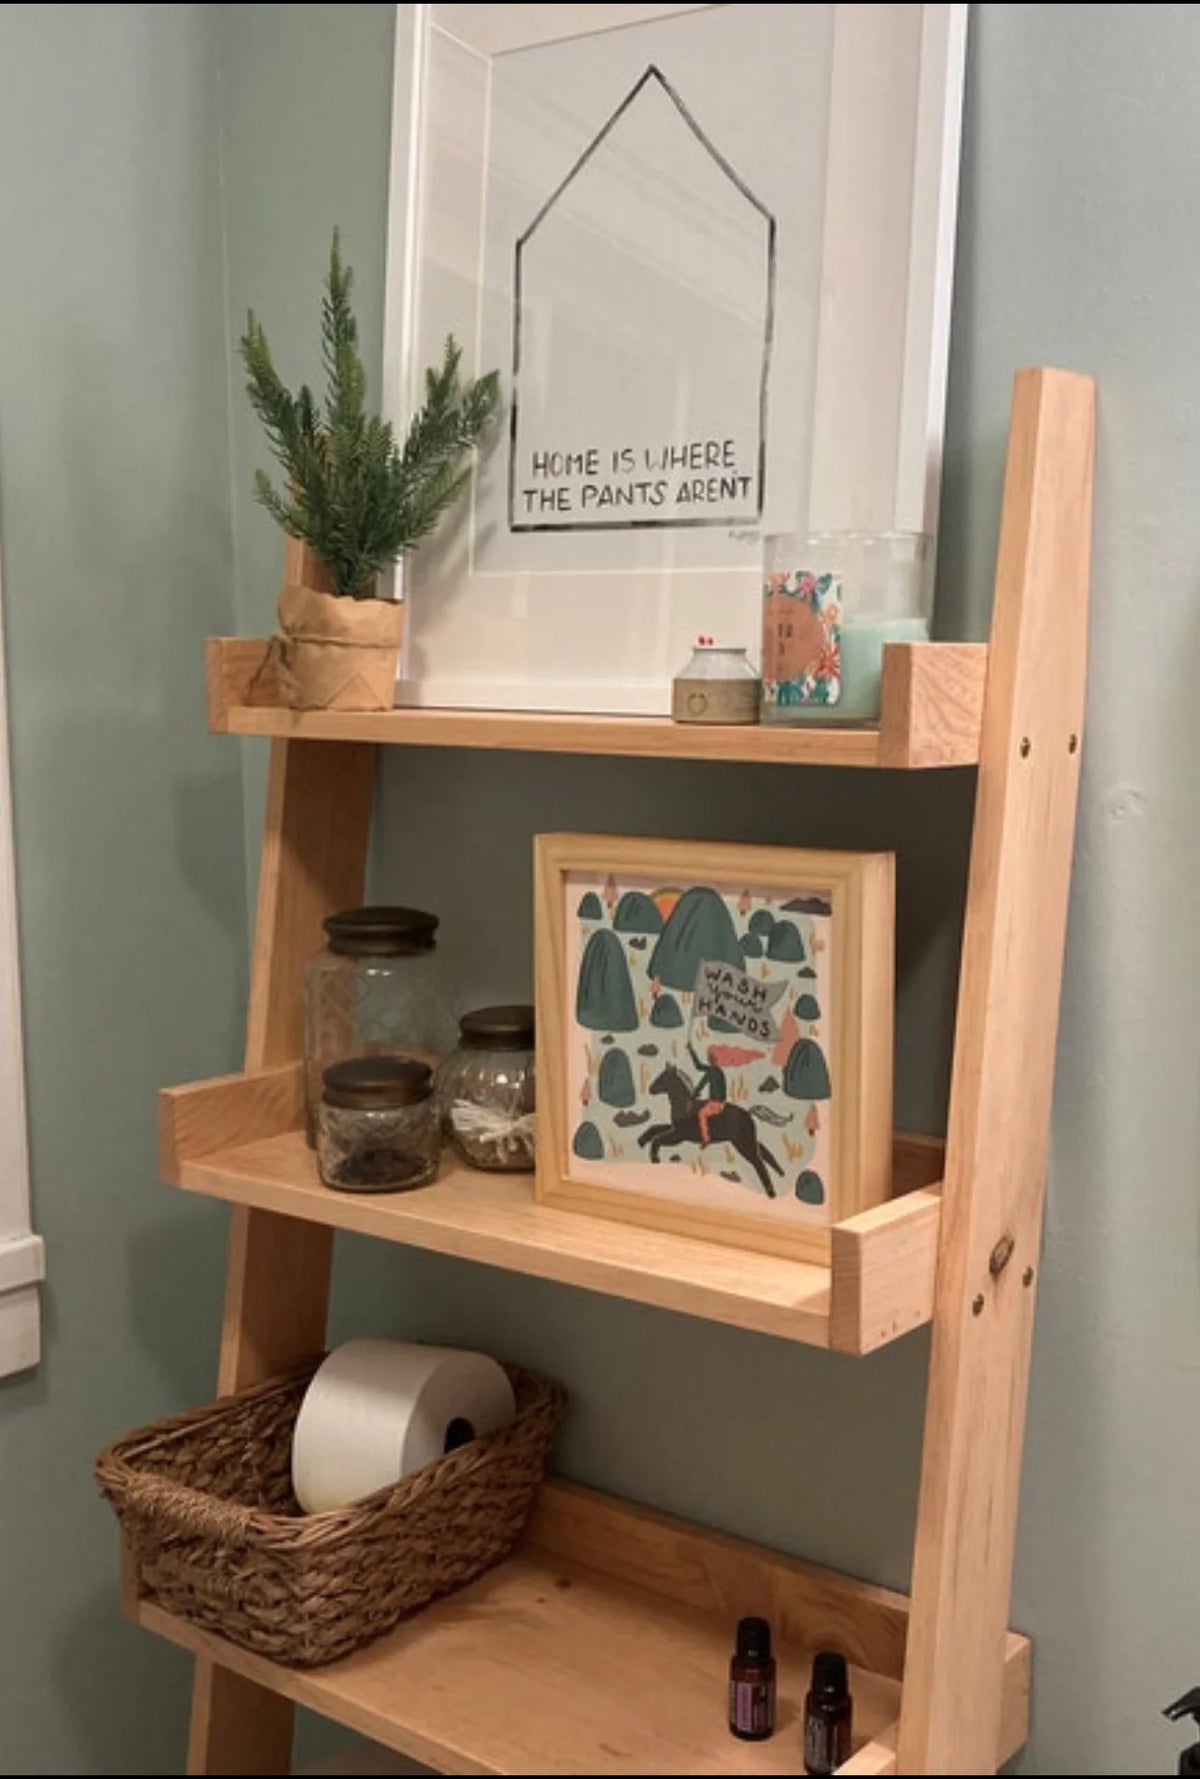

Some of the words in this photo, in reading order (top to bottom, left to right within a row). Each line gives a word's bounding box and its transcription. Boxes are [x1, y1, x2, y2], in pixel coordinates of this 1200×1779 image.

[531, 449, 600, 479] HOME
[612, 448, 636, 474] IS
[645, 439, 737, 471] WHERE
[522, 487, 572, 512] THE
[581, 480, 668, 508] PANTS
[704, 966, 766, 1001] WASH
[698, 998, 770, 1037] HANDS
